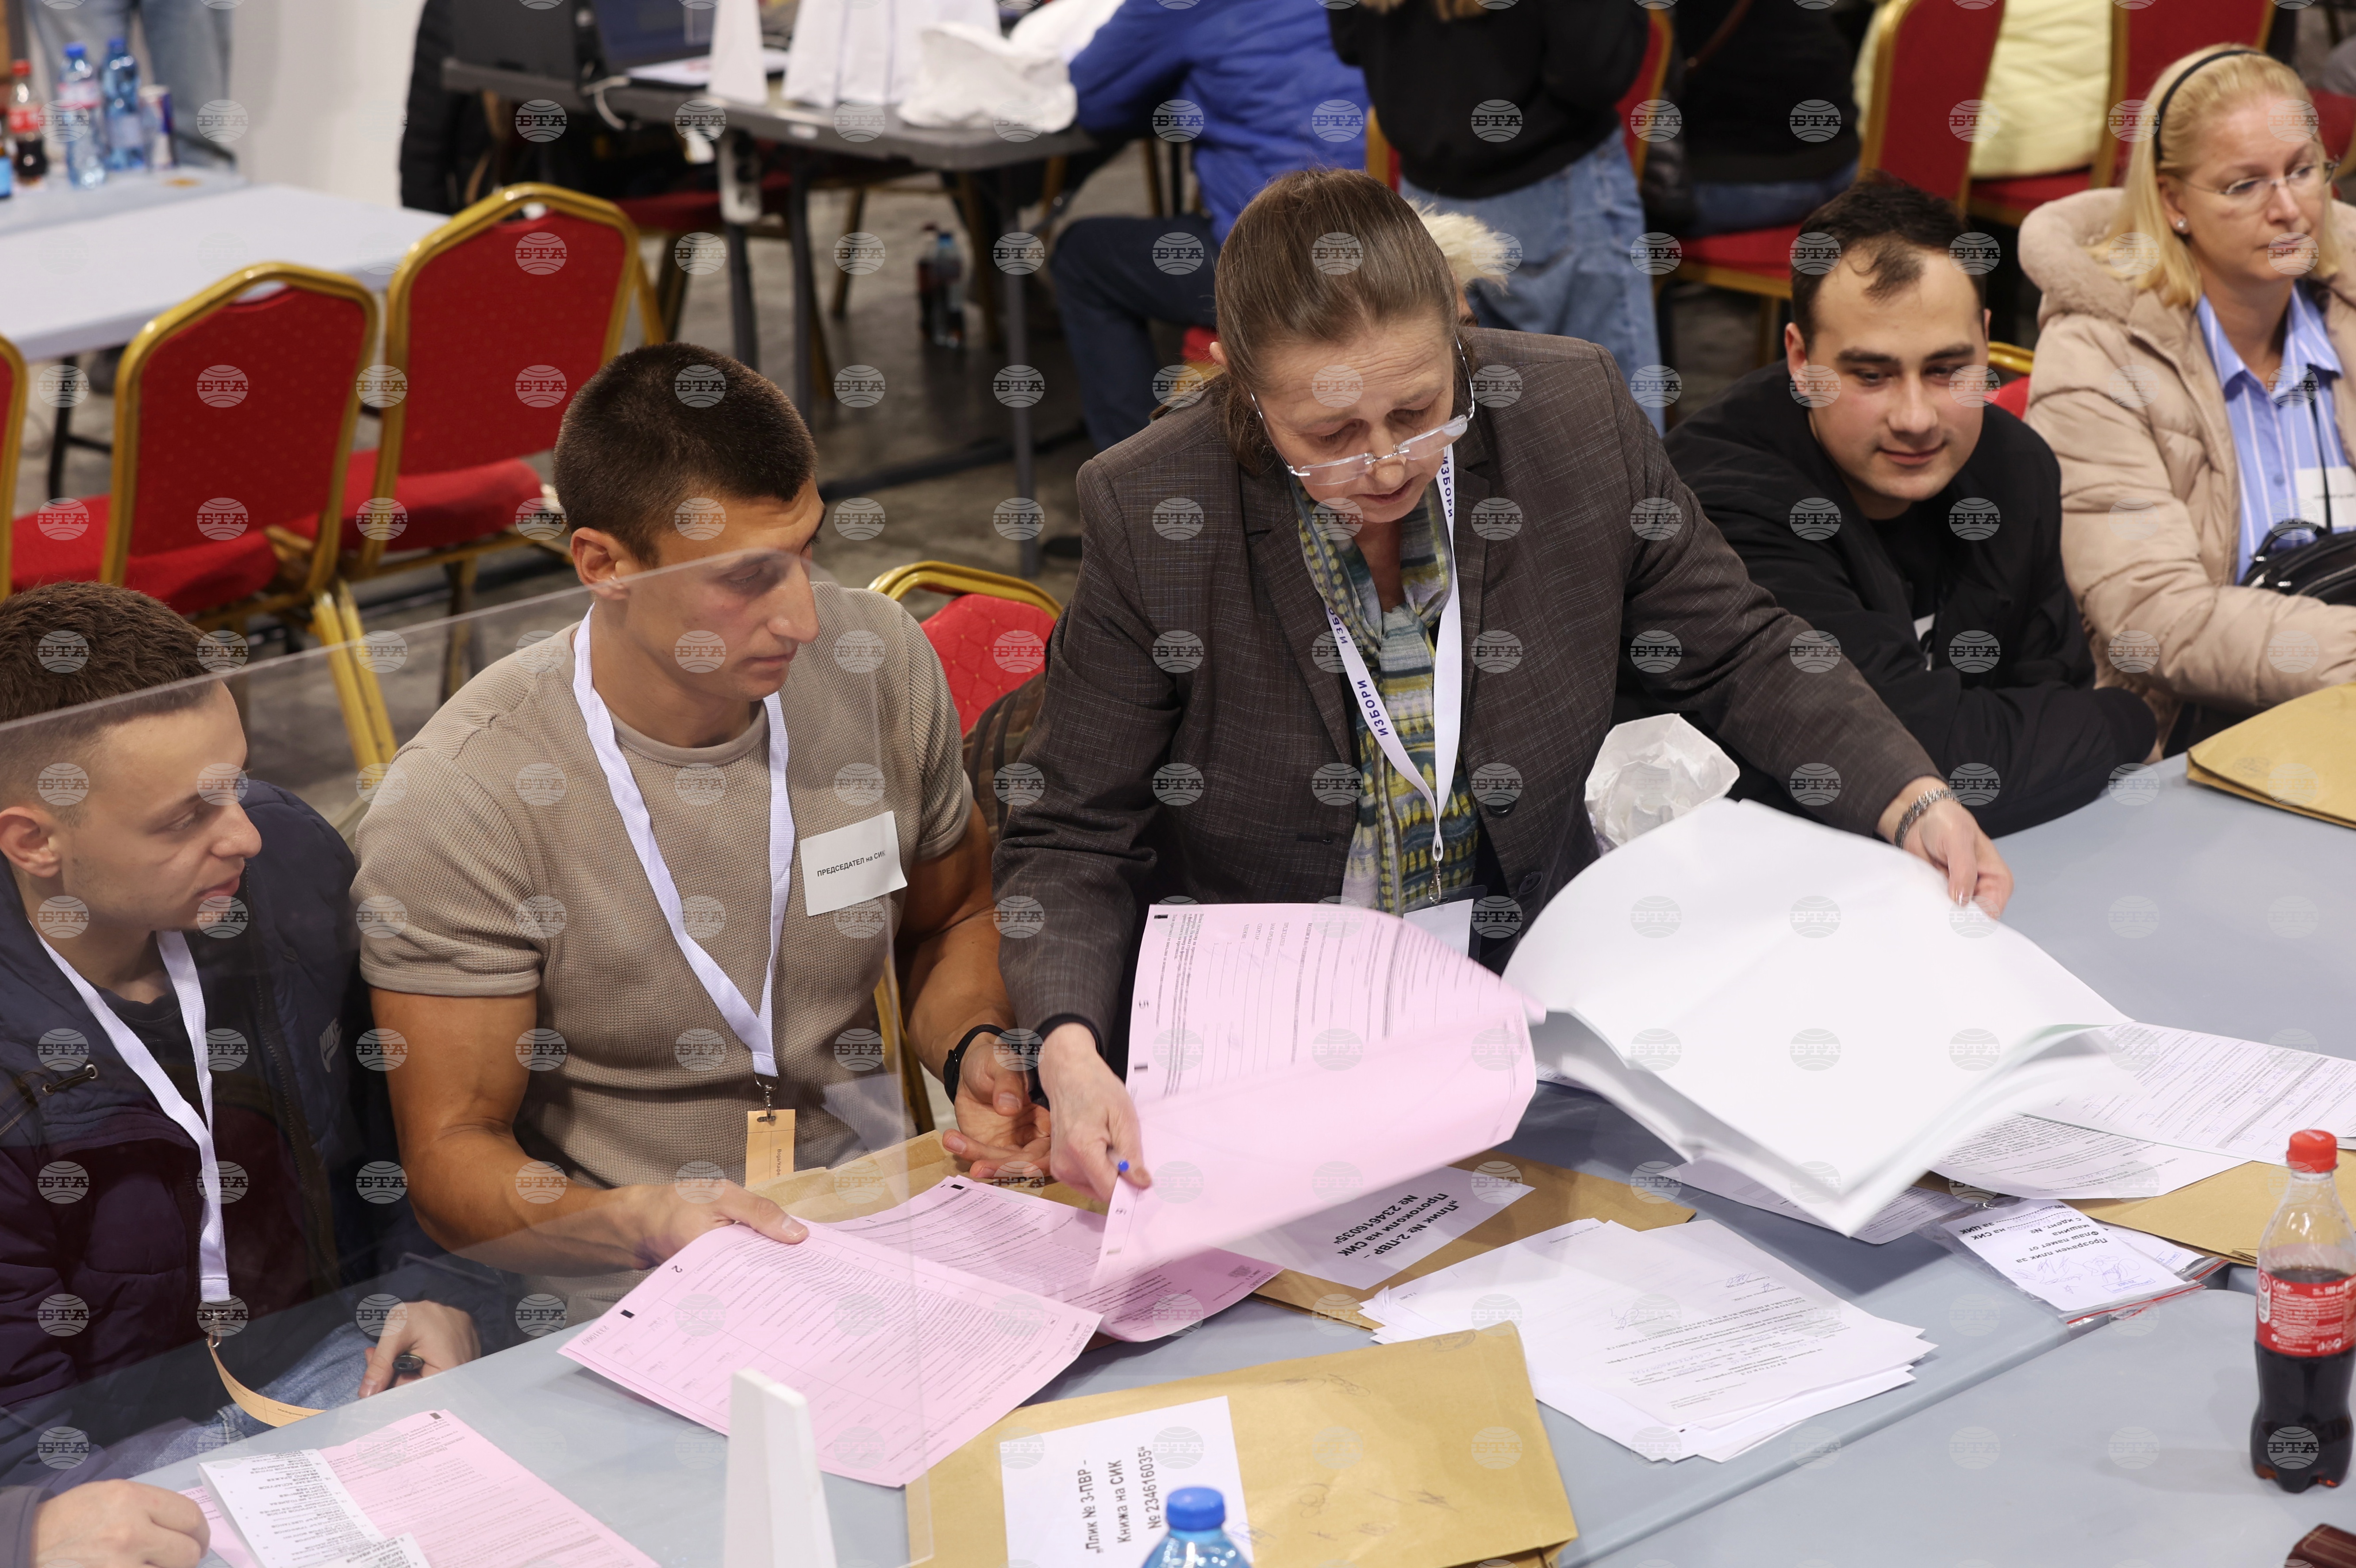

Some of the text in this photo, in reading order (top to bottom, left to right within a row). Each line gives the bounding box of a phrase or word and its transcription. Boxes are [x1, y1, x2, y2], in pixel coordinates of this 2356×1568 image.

[1357, 680, 1388, 736] ИЗБОРИ
[817, 858, 865, 877] ПРЕДСЕДАТЕЛ
[874, 850, 885, 859] СИК
[1422, 1200, 1460, 1223] „Плик
[1334, 1195, 1419, 1244] № 234616035“
[1337, 1193, 1449, 1256] Протоколи на СИК
[2043, 1216, 2074, 1230] идент.
[1407, 1224, 1427, 1233] №
[1959, 1224, 1980, 1235] ЦИК
[1971, 1231, 1991, 1241] СИК
[2052, 1223, 2090, 1236] машина
[2070, 1230, 2099, 1241] Флаш
[1373, 1234, 1411, 1254] 2-ПВР
[2041, 1237, 2068, 1248] памет
[2054, 1237, 2107, 1254] Прозрачен
[2029, 1250, 2053, 1261] плик
[670, 1263, 683, 1275] 2
[1779, 1299, 1806, 1307] КОГАТО
[1077, 1469, 1094, 1503] 3-ПВР
[1138, 1446, 1162, 1529] № 234616035“
[1108, 1460, 1131, 1543] Книжа на СИК
[1082, 1505, 1096, 1518] №
[1086, 1521, 1103, 1553] „Плик
